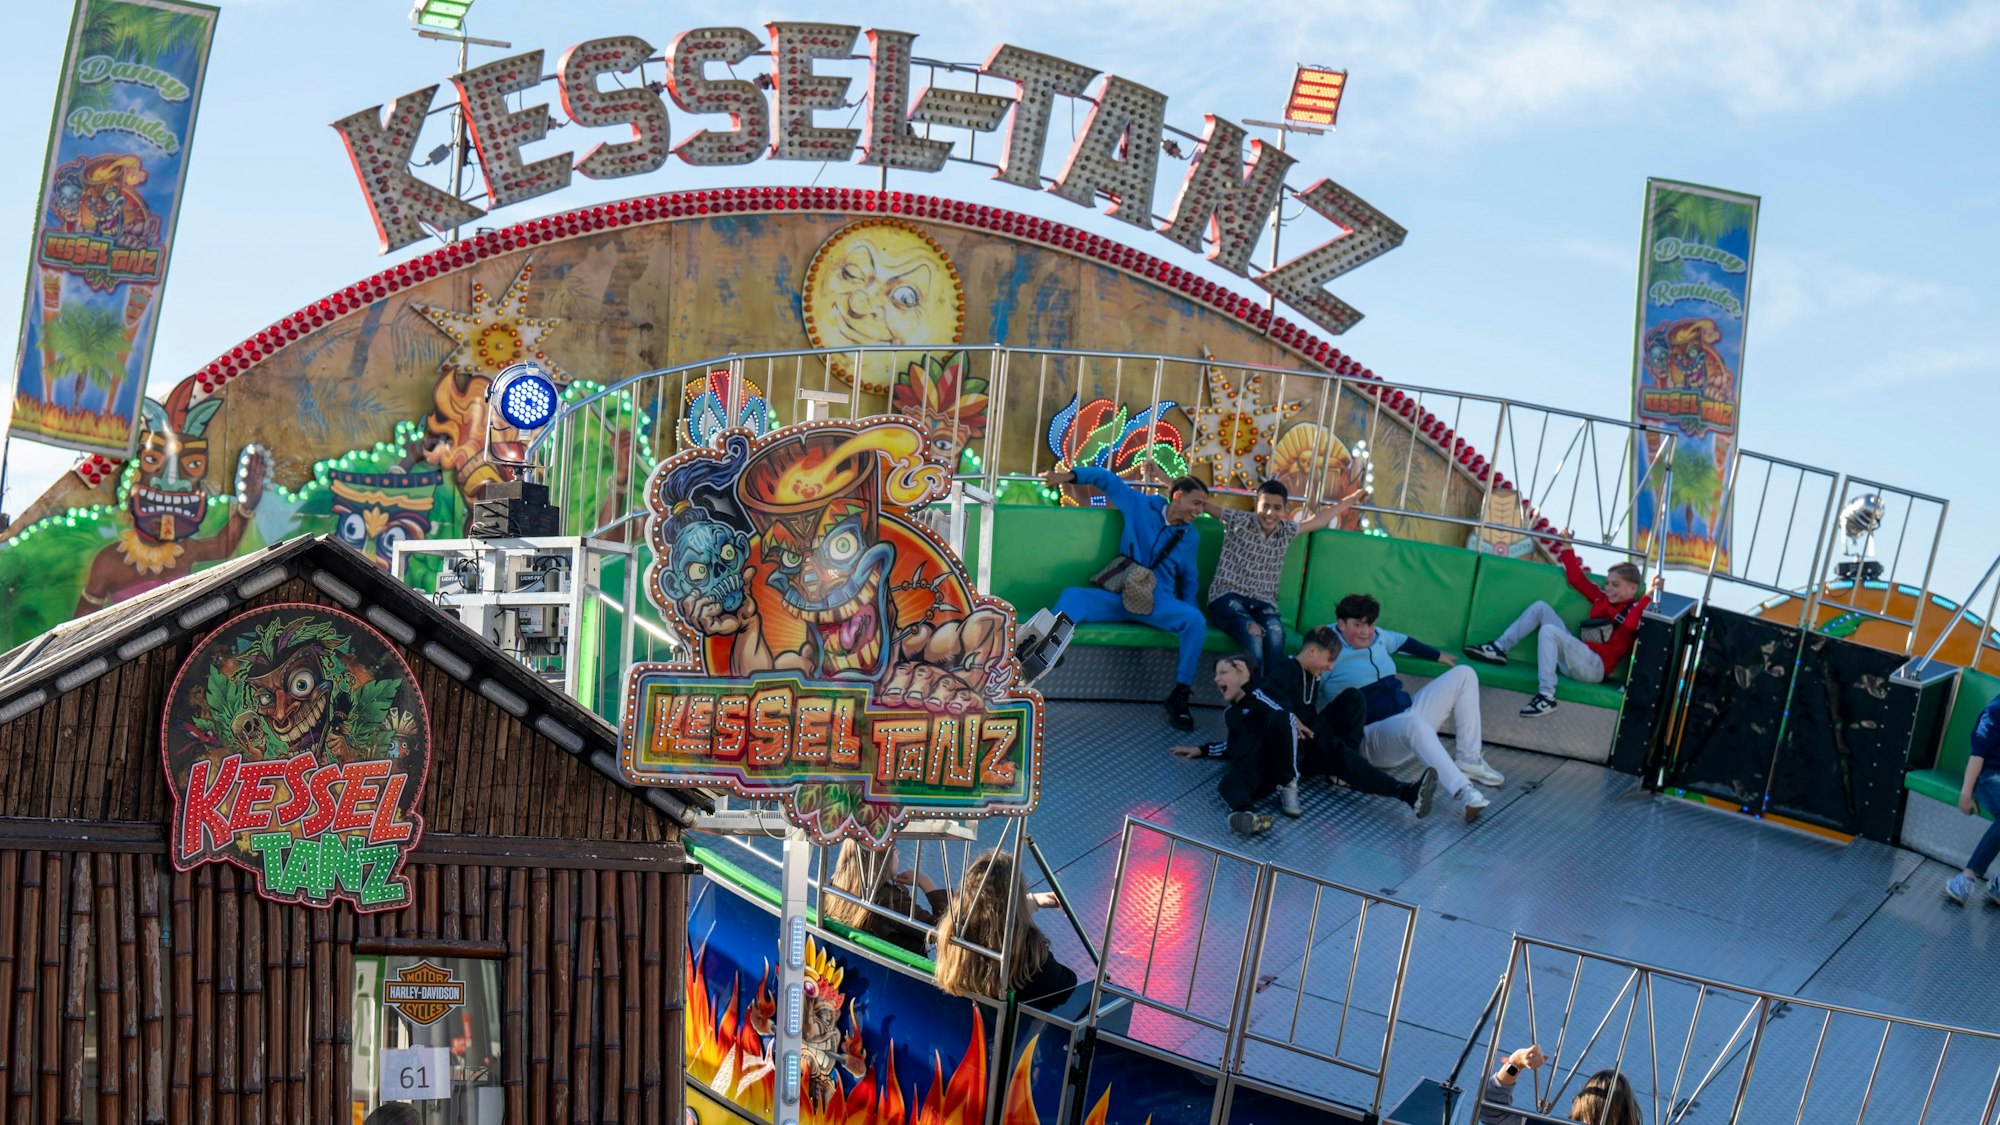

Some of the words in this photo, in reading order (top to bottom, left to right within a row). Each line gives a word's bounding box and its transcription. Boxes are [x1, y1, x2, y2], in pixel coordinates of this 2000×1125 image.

[78, 55, 190, 103] Danny
[67, 106, 180, 156] Reminder
[332, 21, 1408, 335] KESSEL-TANZ
[1654, 236, 1746, 273] Danny
[1650, 280, 1742, 320] Reminder
[688, 526, 712, 550] FUN
[653, 688, 860, 768] KESSEL
[181, 751, 412, 859] KESSEL
[251, 832, 405, 904] TANZ
[390, 985, 459, 999] HARLEY-DAVIDSON
[407, 971, 443, 982] MOTOR
[406, 1004, 443, 1019] CYCLES
[400, 1066, 430, 1089] 61
